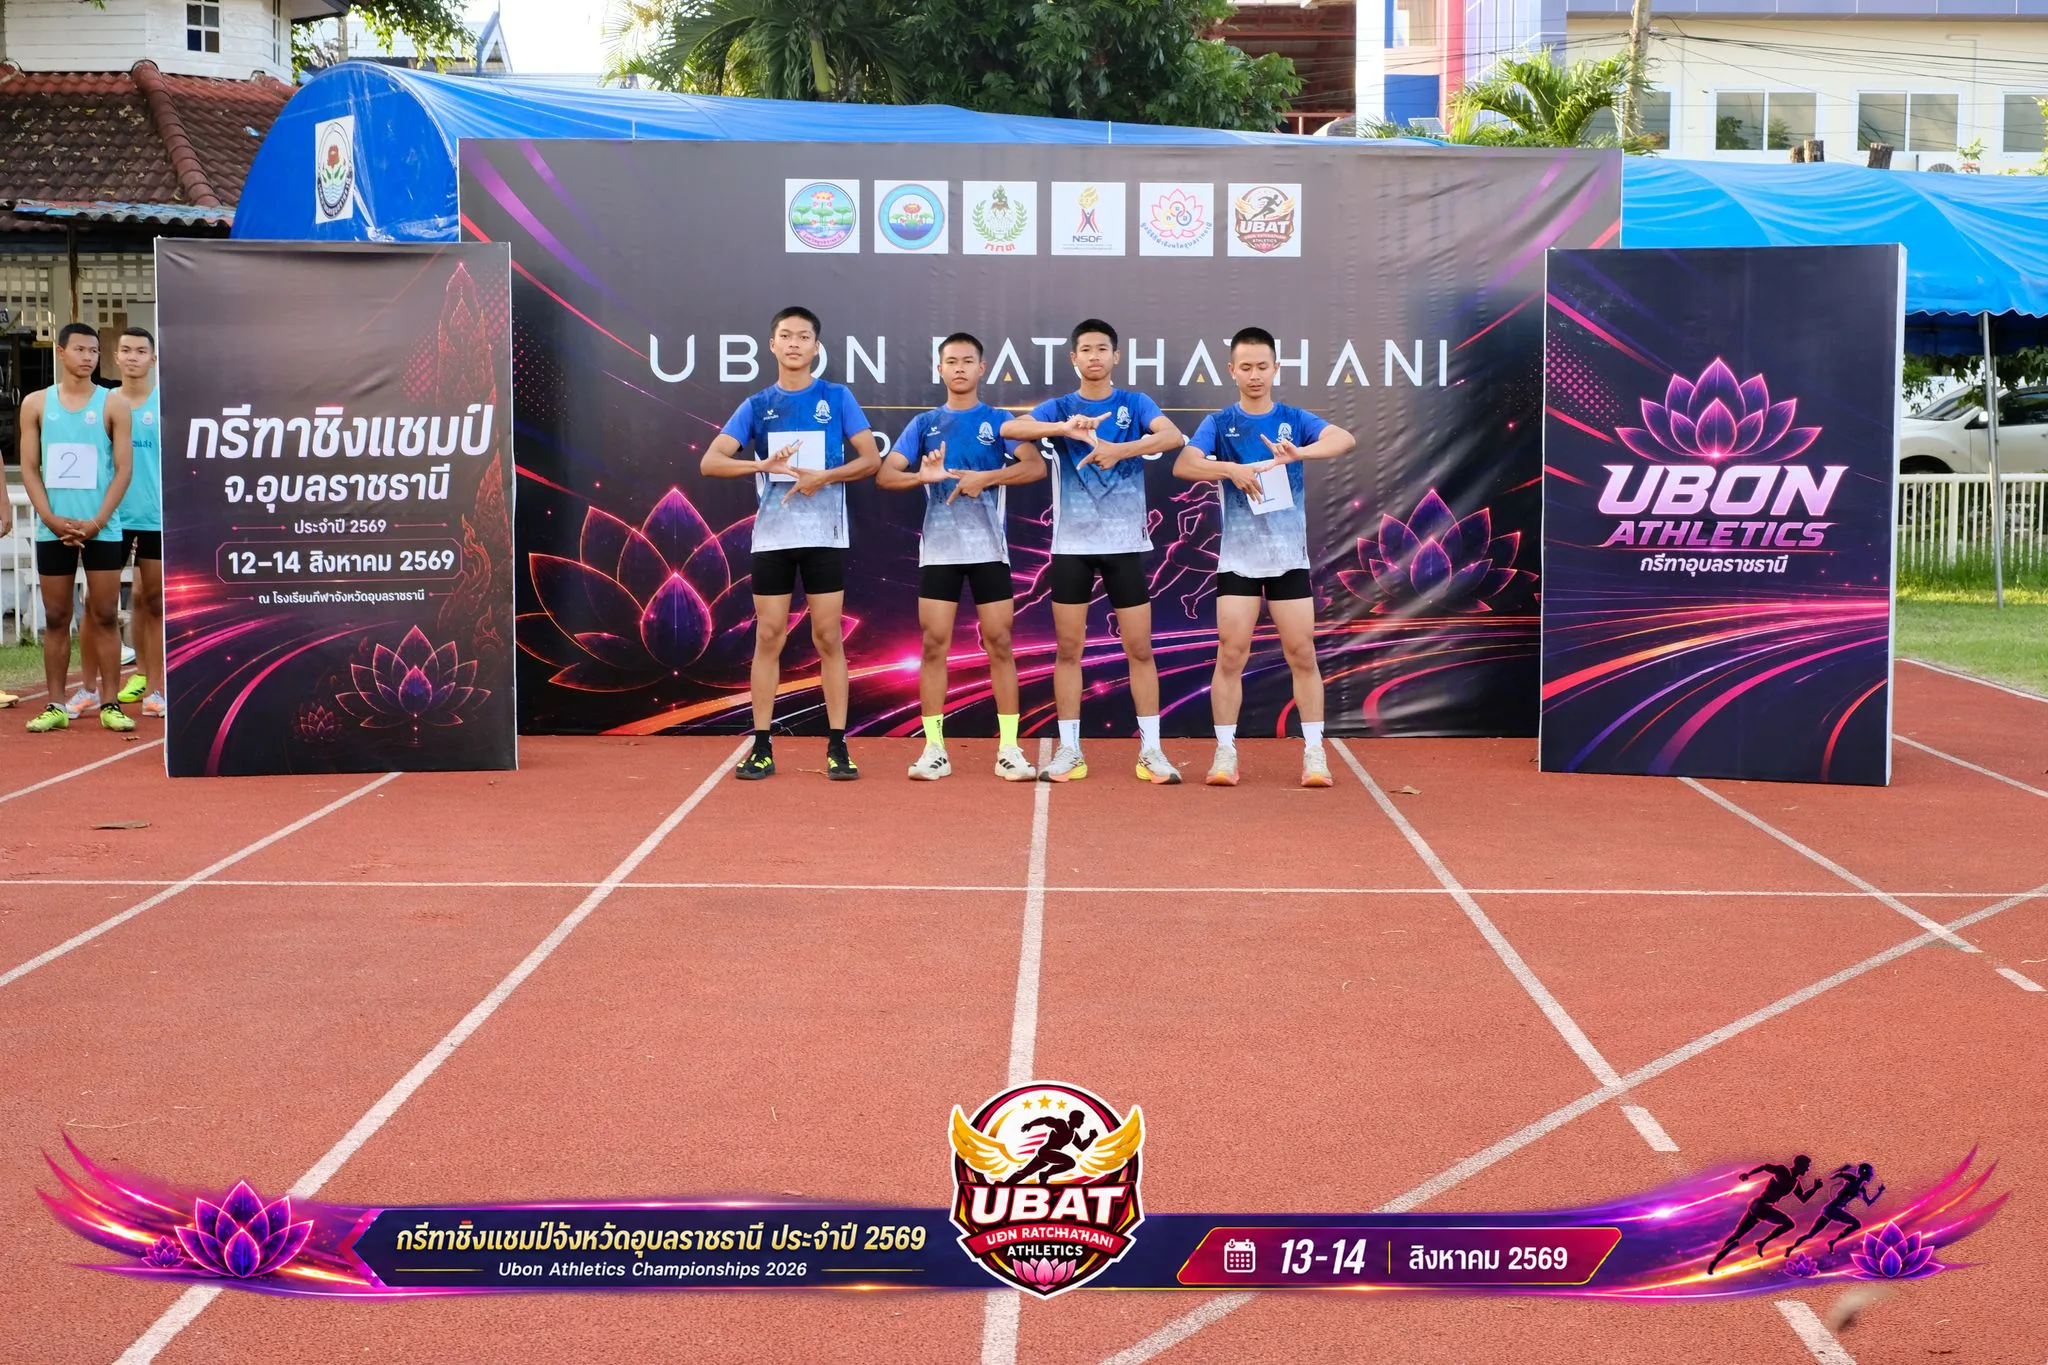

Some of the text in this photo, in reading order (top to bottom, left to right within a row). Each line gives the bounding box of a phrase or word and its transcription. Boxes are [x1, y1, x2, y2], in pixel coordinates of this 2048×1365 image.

[1072, 235, 1103, 243] NSDF
[1240, 220, 1291, 234] UBAT
[932, 336, 1448, 387] ATHAHANI
[186, 403, 495, 459] กรีฑาชิงแชมป์
[57, 451, 81, 479] 2
[224, 463, 451, 514] จ.อุบลราชธานี
[1597, 464, 1851, 517] UBON
[294, 517, 387, 534] ประจำปี 2569
[1598, 521, 1841, 548] ATHLETICS
[309, 550, 392, 573] สิงหาคม
[399, 549, 455, 572] 2569
[1640, 553, 1790, 578] กรีฑาอุบลราชธานี
[258, 588, 425, 605] ณ โรงเรียนกีฬาจังหวัดอุบลราชธานี
